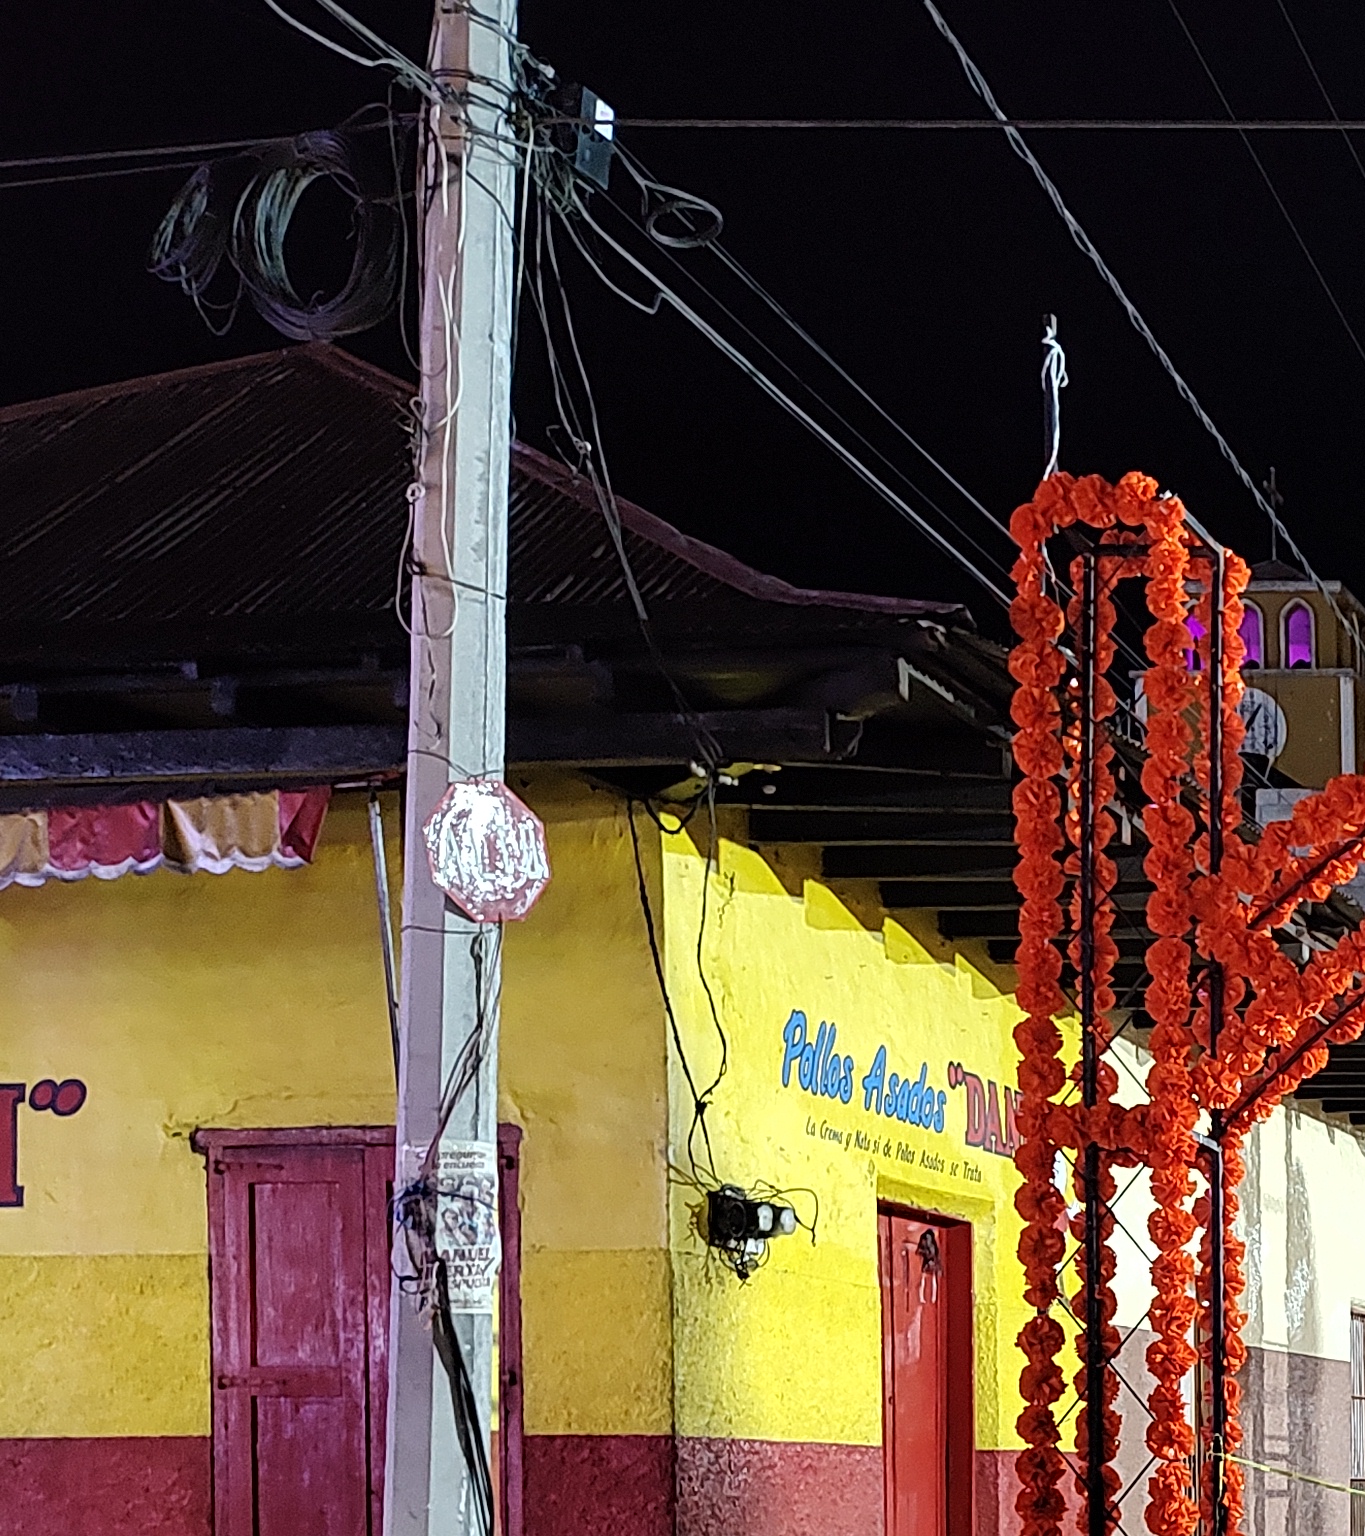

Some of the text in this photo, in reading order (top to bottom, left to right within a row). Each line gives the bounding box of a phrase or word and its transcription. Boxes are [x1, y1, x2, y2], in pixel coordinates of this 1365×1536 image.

[782, 1009, 854, 1104] Pollos
[862, 1045, 947, 1134] Asados
[806, 1116, 816, 1136] La
[895, 1141, 915, 1164] Pollos
[919, 1149, 945, 1173] Asados
[949, 1162, 959, 1177] se
[963, 1161, 982, 1183] Trata
